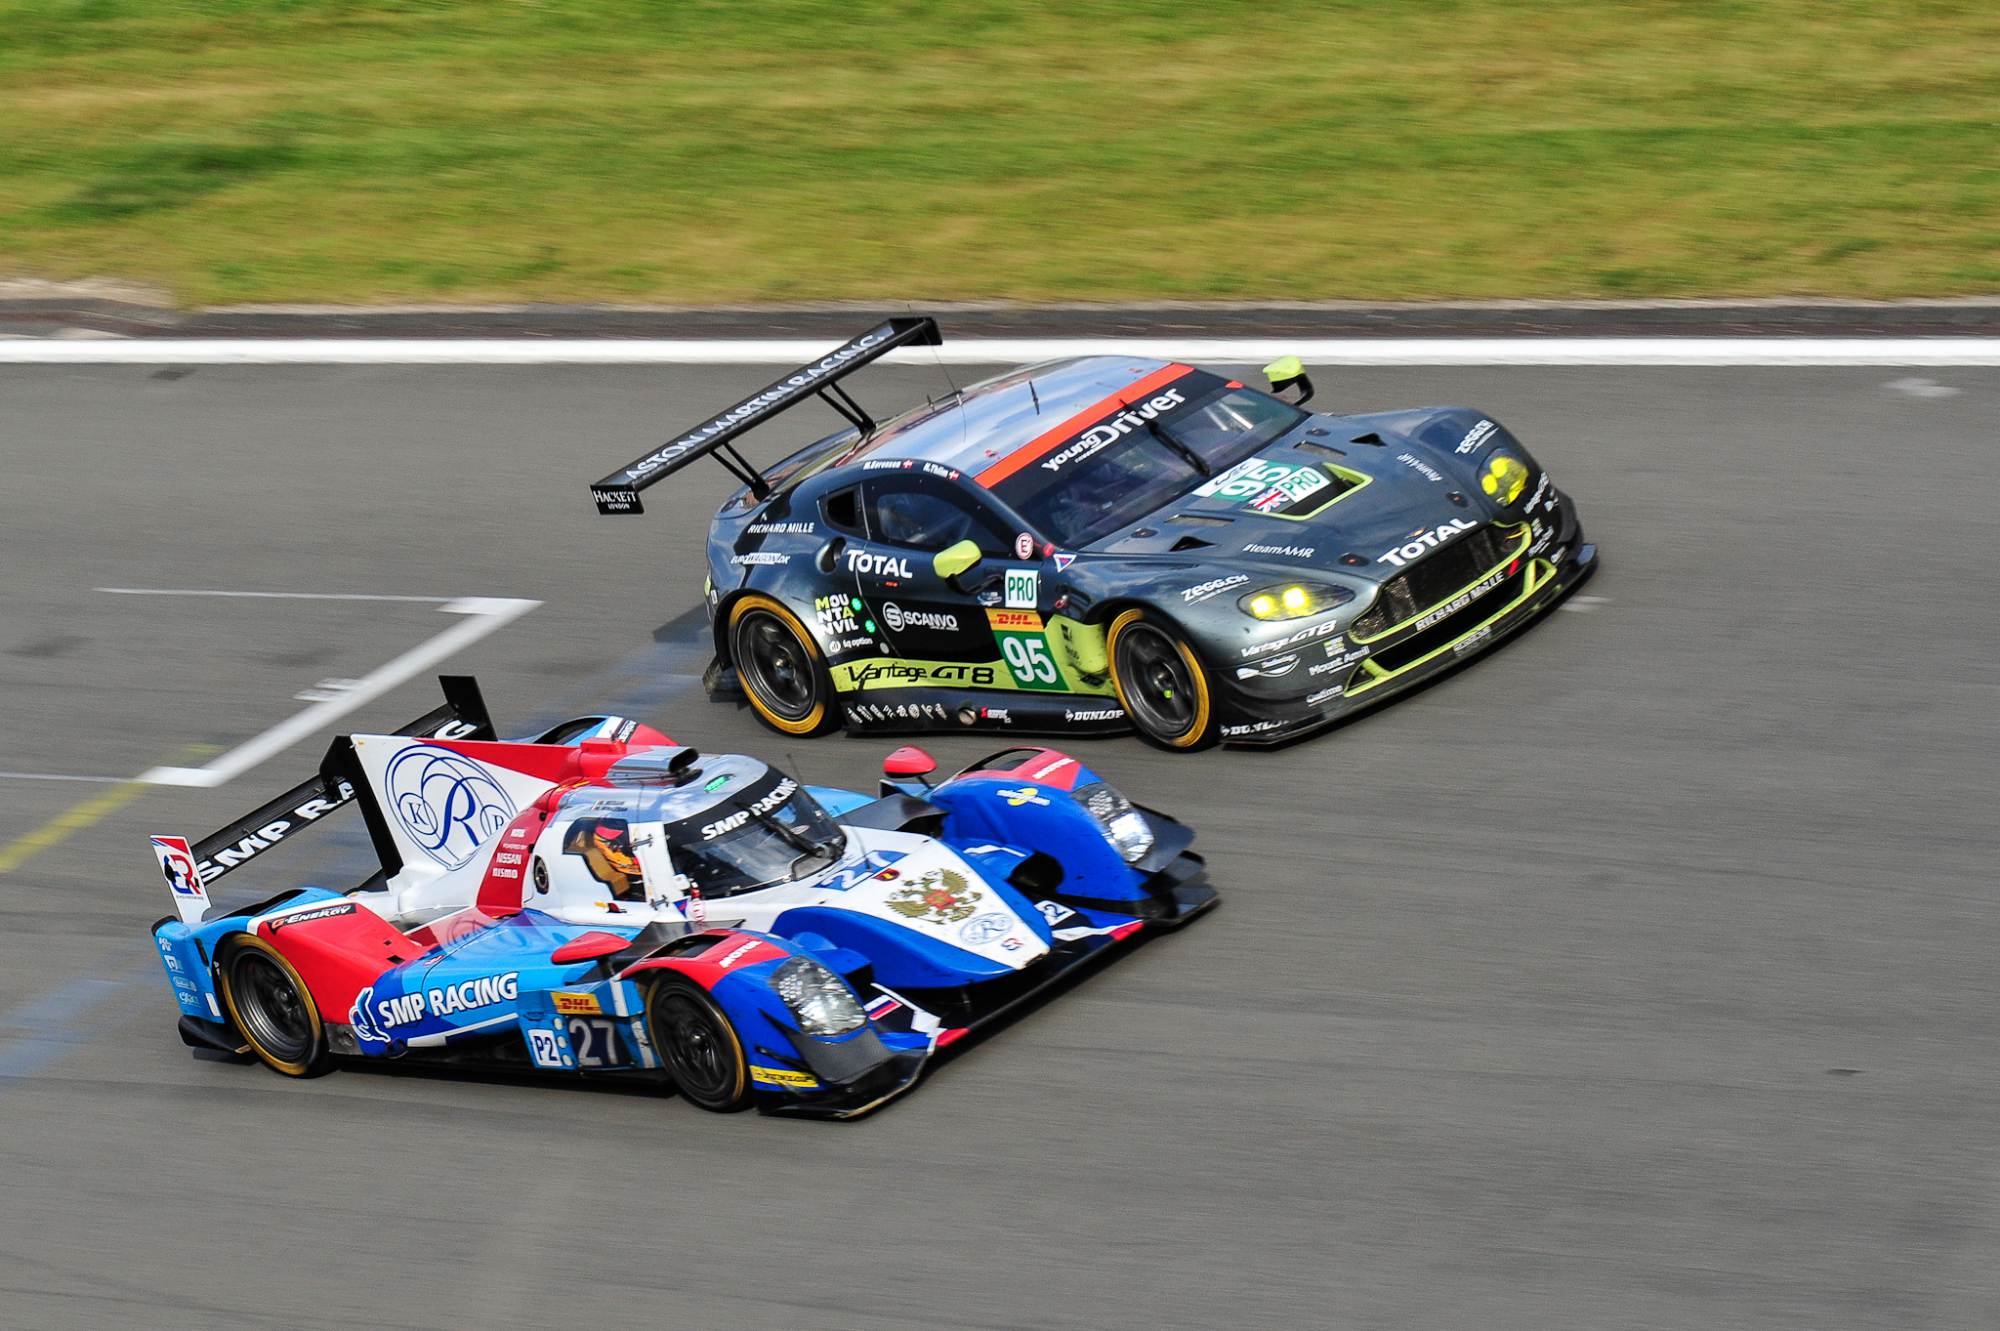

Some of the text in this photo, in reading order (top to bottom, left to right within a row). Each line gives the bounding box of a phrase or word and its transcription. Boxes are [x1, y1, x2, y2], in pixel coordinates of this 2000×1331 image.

[626, 434, 706, 480] ASTON
[702, 385, 794, 435] MARTIN
[1219, 464, 1292, 497] 95
[1279, 470, 1321, 497] PRO
[592, 490, 636, 503] HACKETT
[747, 522, 815, 534] RICHARD MILLE
[1377, 518, 1478, 567] TOTAL
[847, 549, 913, 578] TOTAL
[815, 593, 850, 611] MOU
[1008, 576, 1034, 602] PRO
[817, 606, 855, 623] NTA
[903, 611, 958, 628] SCANVO
[997, 613, 1033, 625] DHL
[848, 663, 927, 683] Vantage
[1002, 636, 1057, 684] 95
[1073, 709, 1125, 721] DUNLOP
[701, 810, 750, 841] SMP
[197, 820, 291, 883] SMP
[377, 971, 520, 1029] SMP RACING
[532, 1035, 558, 1062] P2
[569, 1018, 618, 1066] 27
